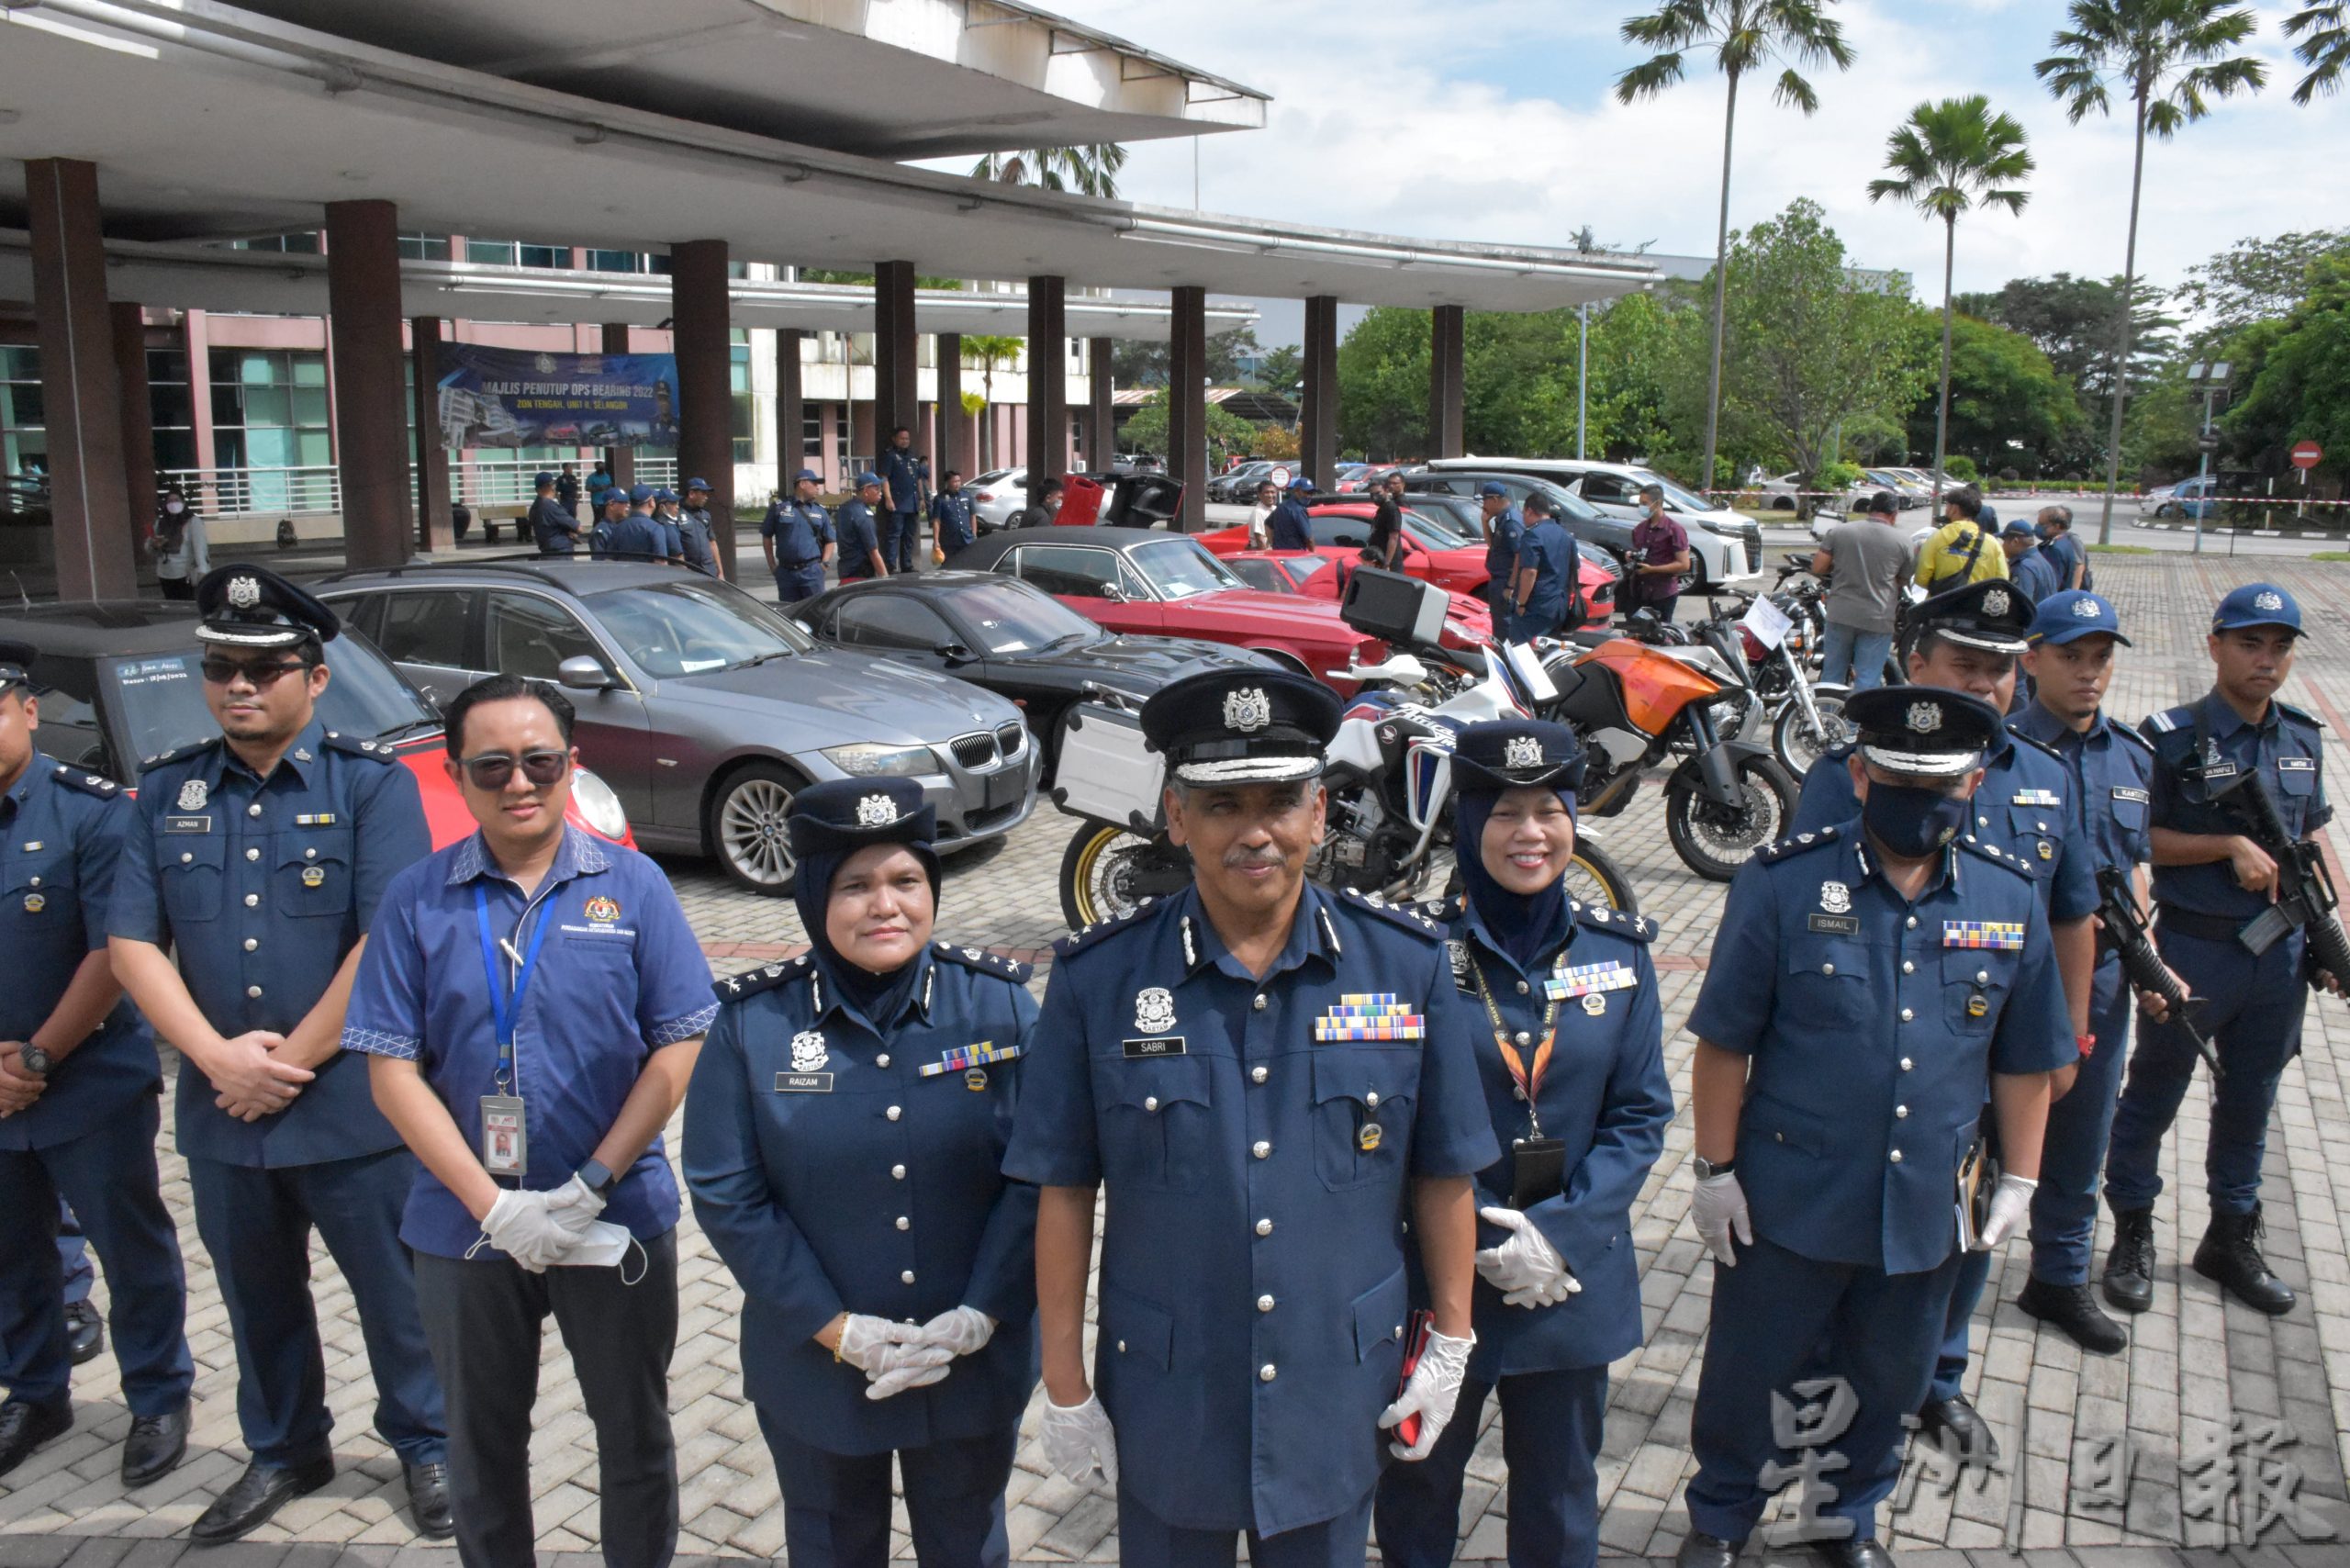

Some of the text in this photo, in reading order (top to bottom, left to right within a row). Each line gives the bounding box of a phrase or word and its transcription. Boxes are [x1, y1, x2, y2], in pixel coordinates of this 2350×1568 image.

[481, 381, 654, 398] MAJLIS PENUTUP OPS BEARING 2022
[176, 820, 198, 828] AZMAN
[1818, 919, 1850, 930] ISMAIL
[1140, 1042, 1166, 1053] SABRI
[789, 1077, 818, 1086] RAIZAM
